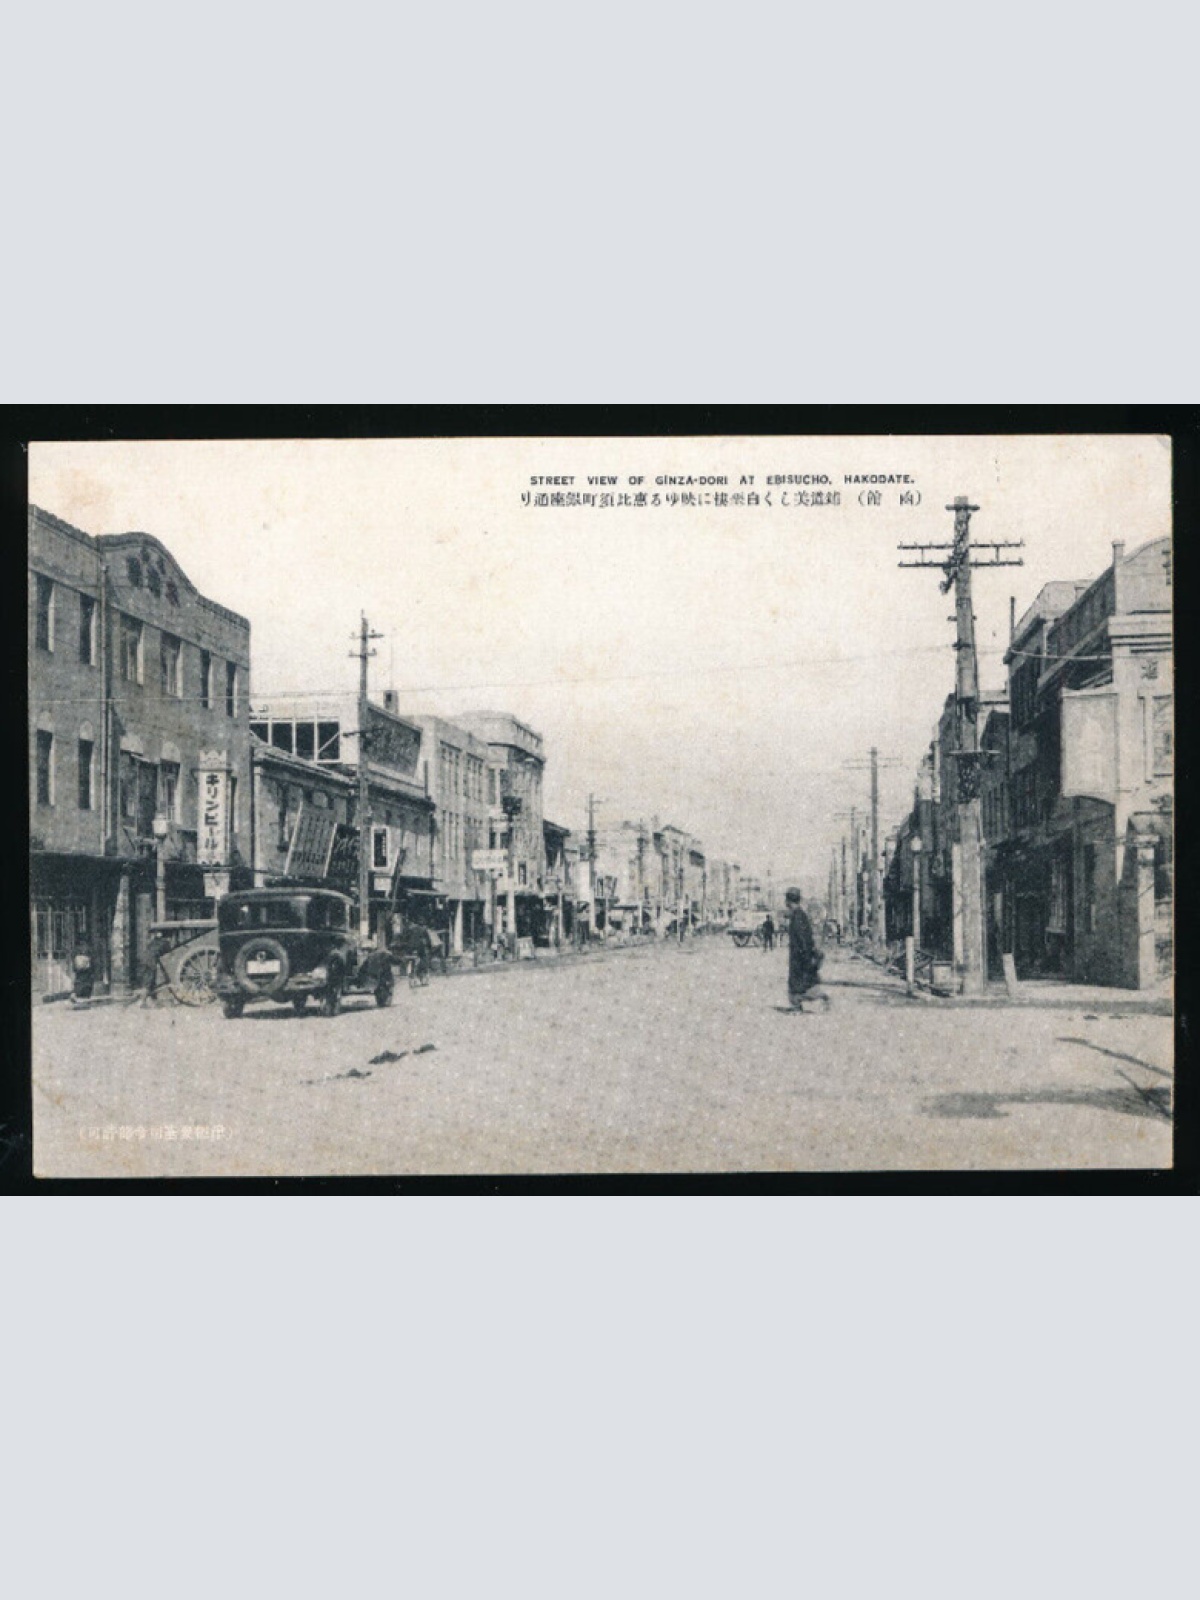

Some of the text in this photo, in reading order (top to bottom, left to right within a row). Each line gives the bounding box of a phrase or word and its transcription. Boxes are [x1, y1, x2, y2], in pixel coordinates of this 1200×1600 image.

[205, 774, 219, 849] キリンビール
